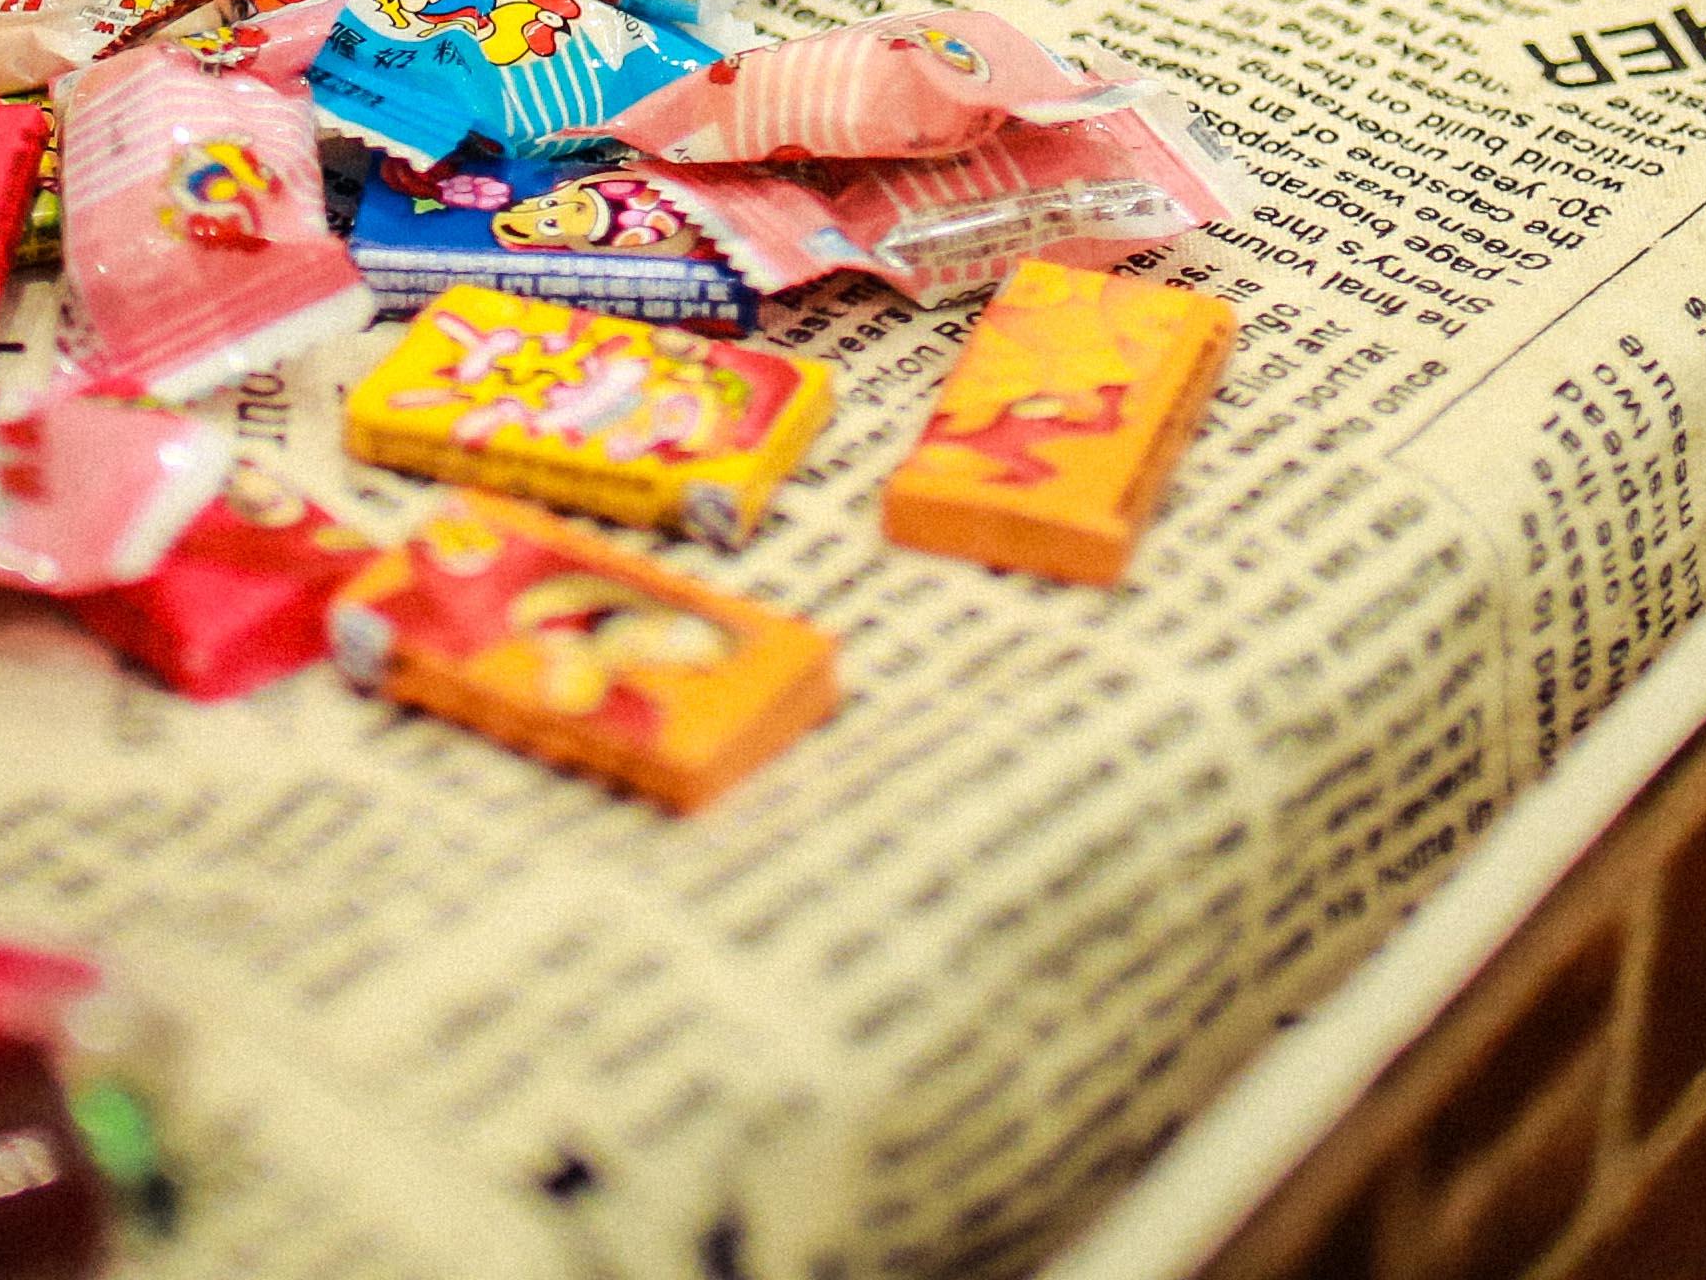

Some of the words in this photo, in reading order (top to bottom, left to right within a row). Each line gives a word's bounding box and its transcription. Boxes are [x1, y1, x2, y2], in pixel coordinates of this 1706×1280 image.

[1249, 98, 1296, 122] an
[1367, 89, 1411, 116] on
[1291, 122, 1339, 146] of
[1413, 112, 1509, 157] build
[1533, 124, 1665, 179] critical
[1334, 168, 1406, 209] was
[1345, 146, 1515, 224] capstone
[1451, 160, 1547, 201] year
[1511, 148, 1625, 196] would
[1413, 204, 1553, 271] Greene
[1522, 218, 1586, 253] the
[1318, 271, 1409, 318] final
[1335, 238, 1494, 315] Sherry's
[1592, 362, 1653, 440] two
[1617, 333, 1693, 531] measure
